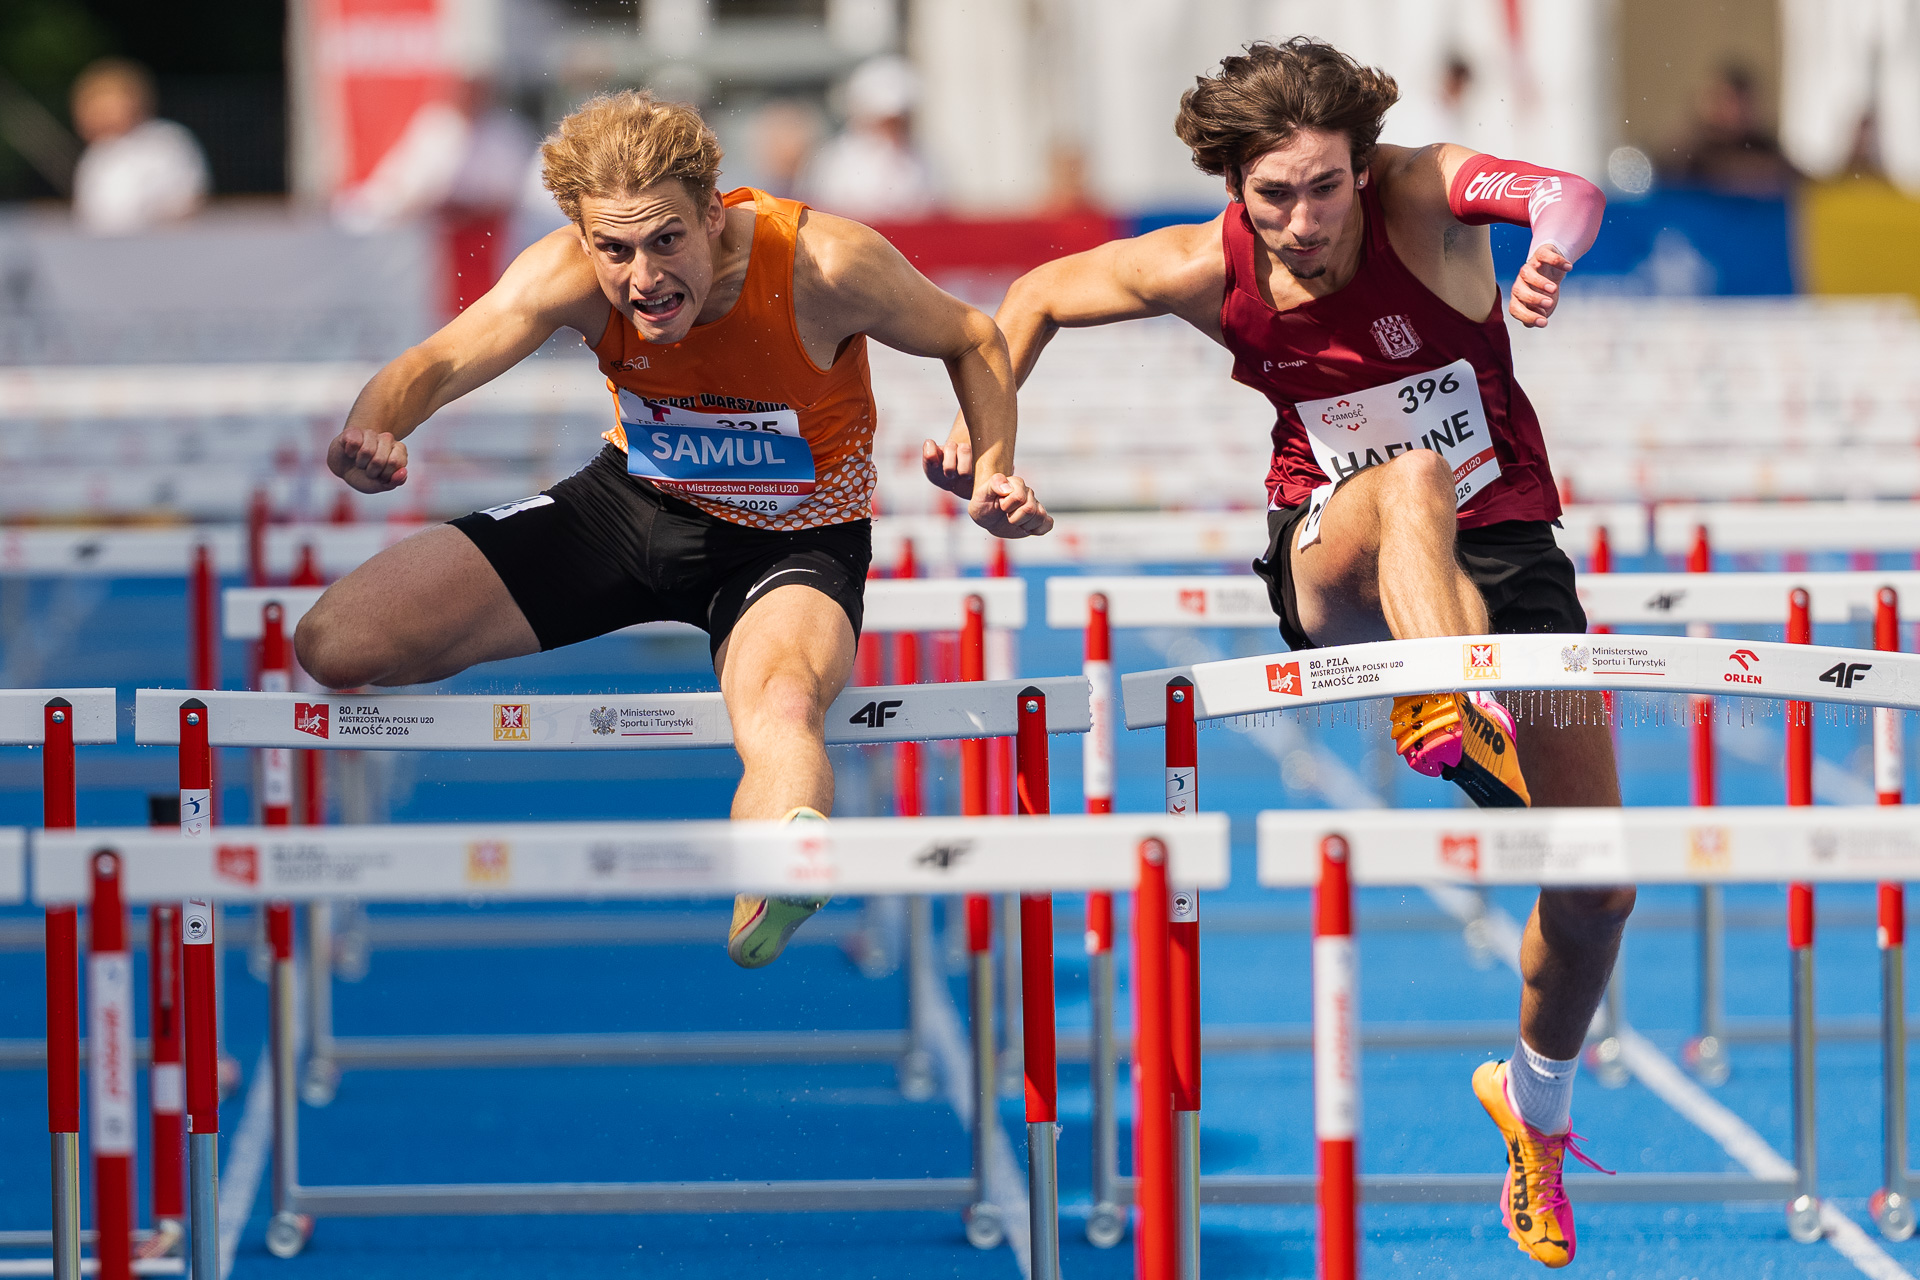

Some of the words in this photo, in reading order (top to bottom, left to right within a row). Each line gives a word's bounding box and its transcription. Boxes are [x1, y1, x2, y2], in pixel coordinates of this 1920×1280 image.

[1397, 371, 1460, 414] 396
[1330, 409, 1364, 421] ZAMOŚĆ
[651, 432, 786, 466] SAMUL
[1466, 456, 1481, 472] U20
[686, 484, 746, 493] Mistrzostwa
[748, 484, 777, 493] Polski
[779, 484, 799, 493] U20
[739, 499, 778, 511] 2026
[1592, 647, 1648, 656] Ministerstwo
[1309, 659, 1324, 670] 80.
[1326, 657, 1349, 668] PZLA
[1592, 656, 1621, 668] Sportu
[1628, 657, 1666, 668] Turystyki
[1310, 665, 1361, 678] MISTRZOSTWA
[1362, 662, 1388, 672] POLSKI
[1389, 660, 1404, 669] U20
[1465, 667, 1499, 679] PZLA
[1311, 674, 1355, 690] ZAMOŚĆ
[1356, 673, 1380, 685] 2026
[1724, 673, 1762, 685] ORLEN
[1819, 662, 1873, 689] 4F
[338, 706, 354, 715] 80.
[356, 706, 380, 715] PZLA
[620, 708, 676, 717] Ministerstwo
[849, 699, 904, 728] 4F
[338, 716, 391, 724] MISTRZOSTWA
[392, 716, 419, 724] POLSKI
[420, 716, 434, 724] U20
[620, 718, 649, 728] Sportu
[655, 718, 693, 728] Turystyki
[338, 724, 384, 735] ZAMOŚĆ
[386, 726, 410, 735] 2026
[494, 729, 529, 740] PZLA
[1509, 1130, 1533, 1232] NITRO
